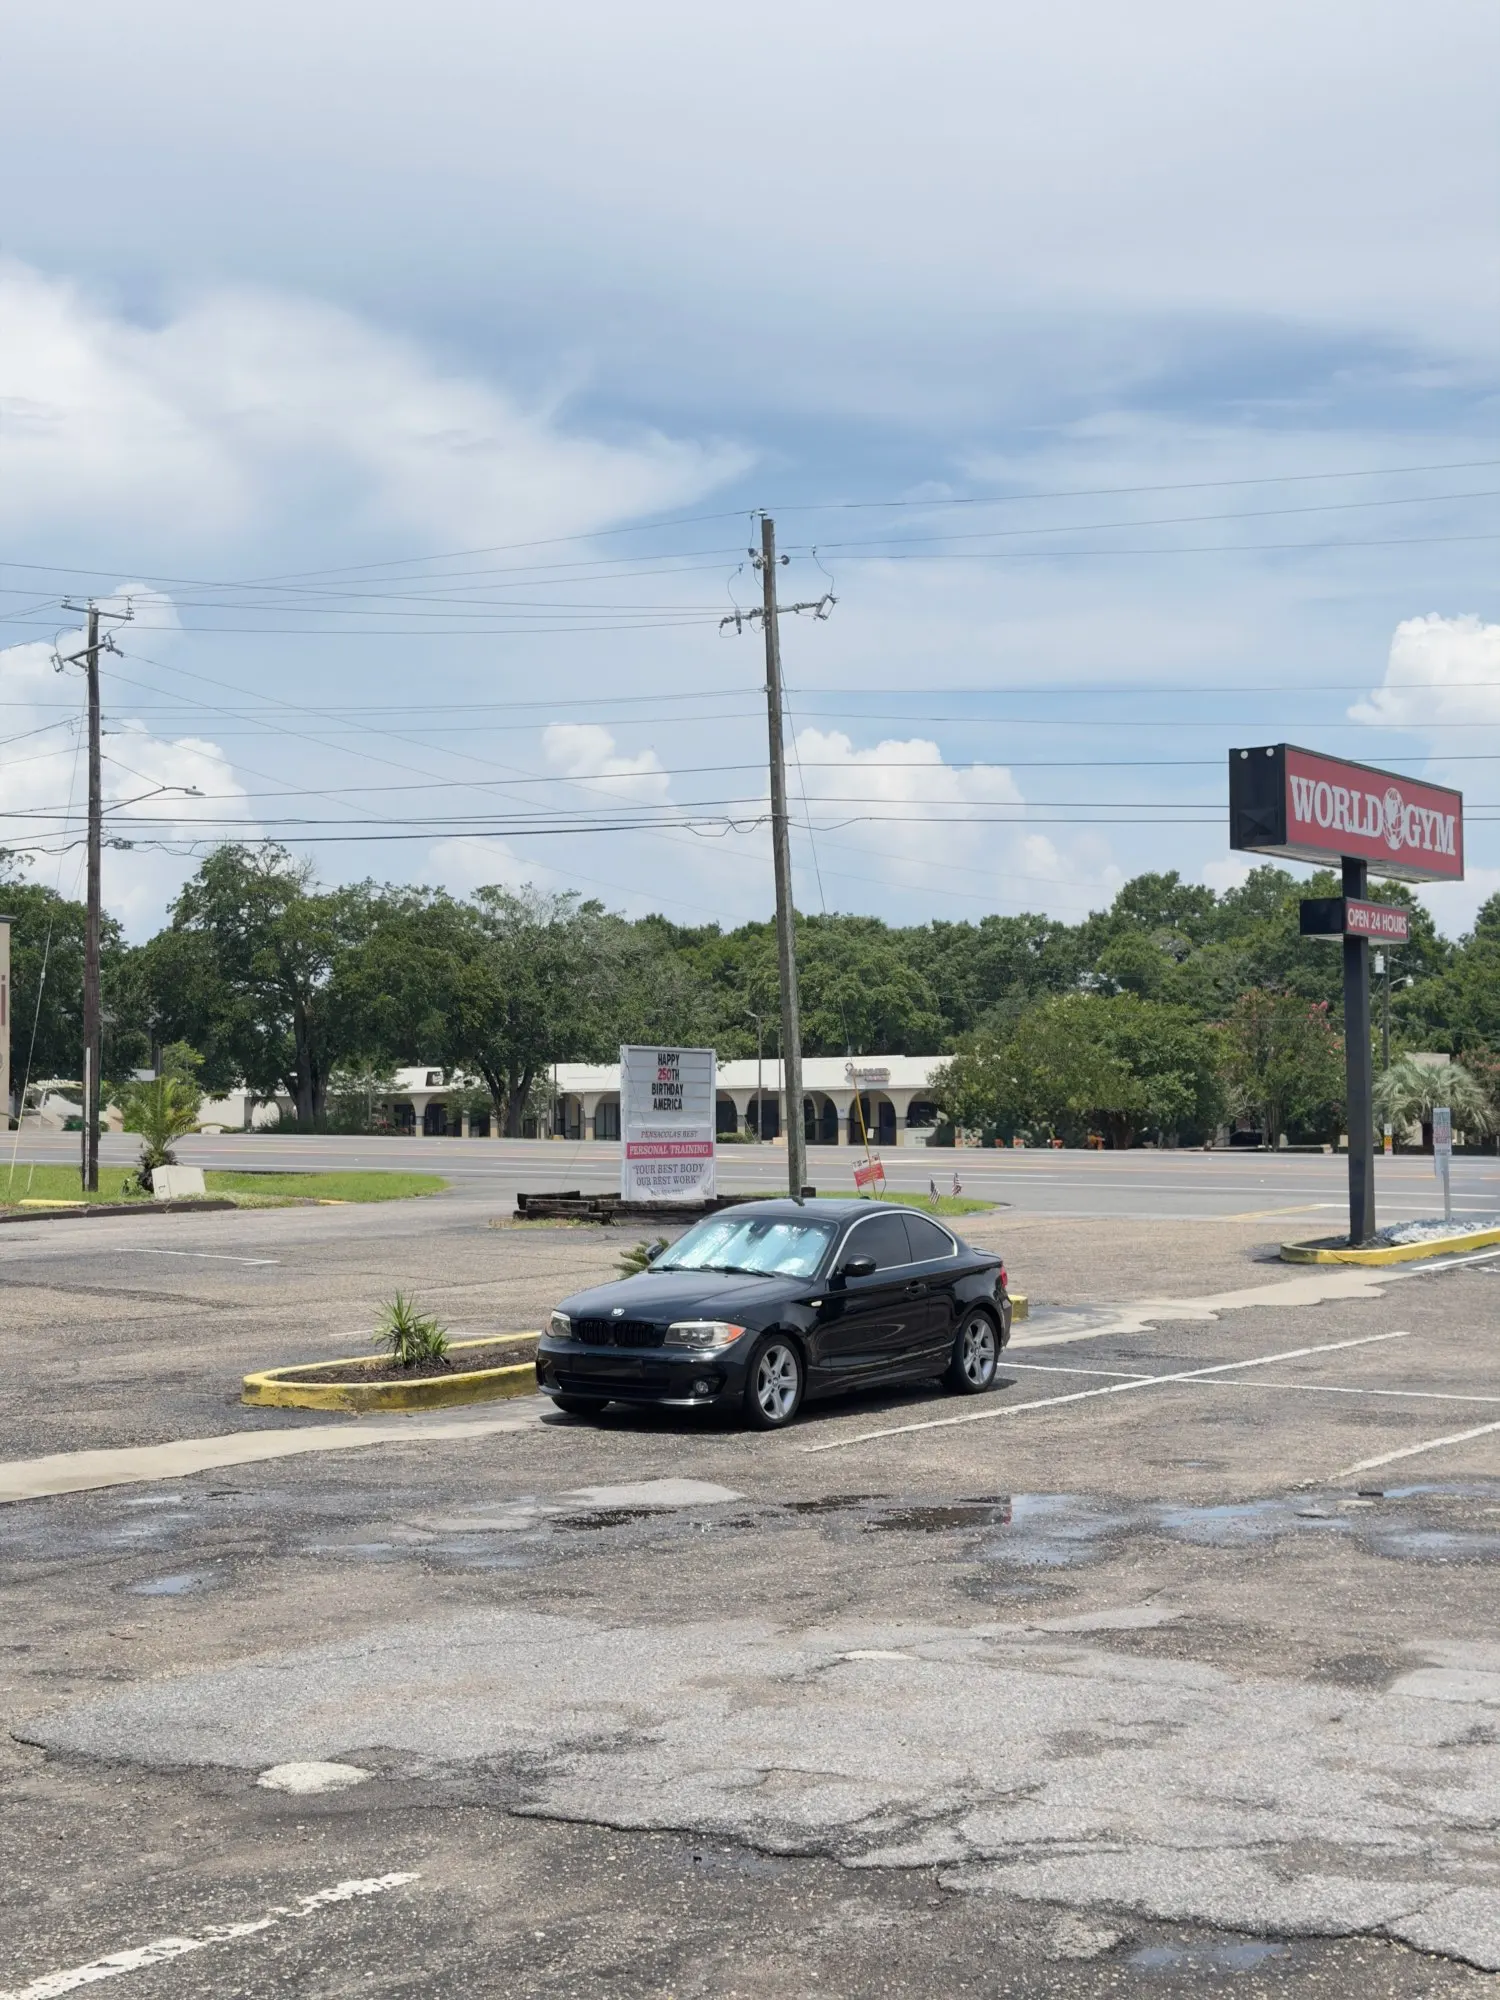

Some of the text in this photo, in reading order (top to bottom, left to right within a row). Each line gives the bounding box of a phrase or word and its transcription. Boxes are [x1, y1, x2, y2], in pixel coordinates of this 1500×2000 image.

[1289, 775, 1456, 856] WORLD GYM
[1348, 908, 1407, 934] OPEN 24 HOURS
[657, 1053, 680, 1066] HAPPY
[657, 1068, 680, 1081] 250TH
[651, 1083, 684, 1096] BIRTHDAY
[653, 1098, 683, 1111] AMERICA
[683, 1130, 699, 1138] BEST
[629, 1144, 709, 1155] PERSONAL TRAINING
[657, 1163, 678, 1174] BEST
[636, 1177, 652, 1187] OUR
[653, 1176, 672, 1186] BEST
